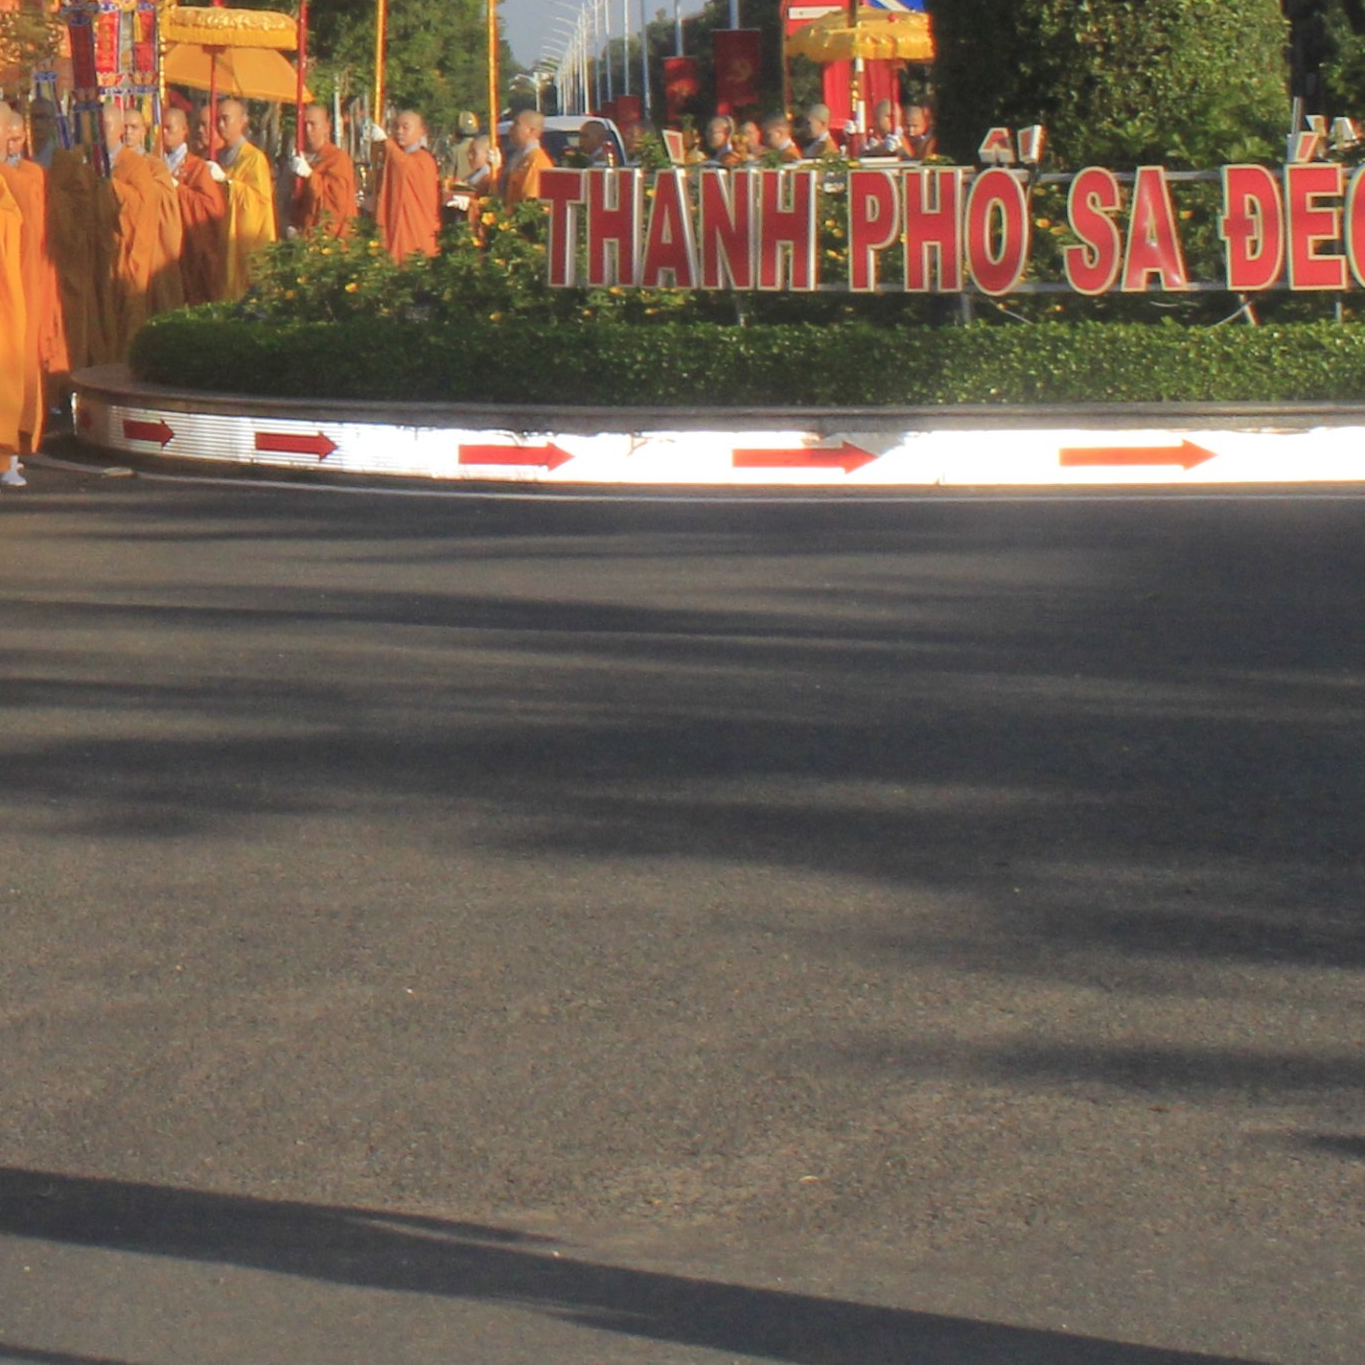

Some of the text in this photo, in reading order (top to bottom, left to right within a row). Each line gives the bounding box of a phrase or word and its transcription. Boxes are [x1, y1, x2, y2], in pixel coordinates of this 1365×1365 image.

[539, 129, 818, 292] THÀNH
[847, 125, 1046, 296] PHỐ
[1063, 165, 1190, 296] SA
